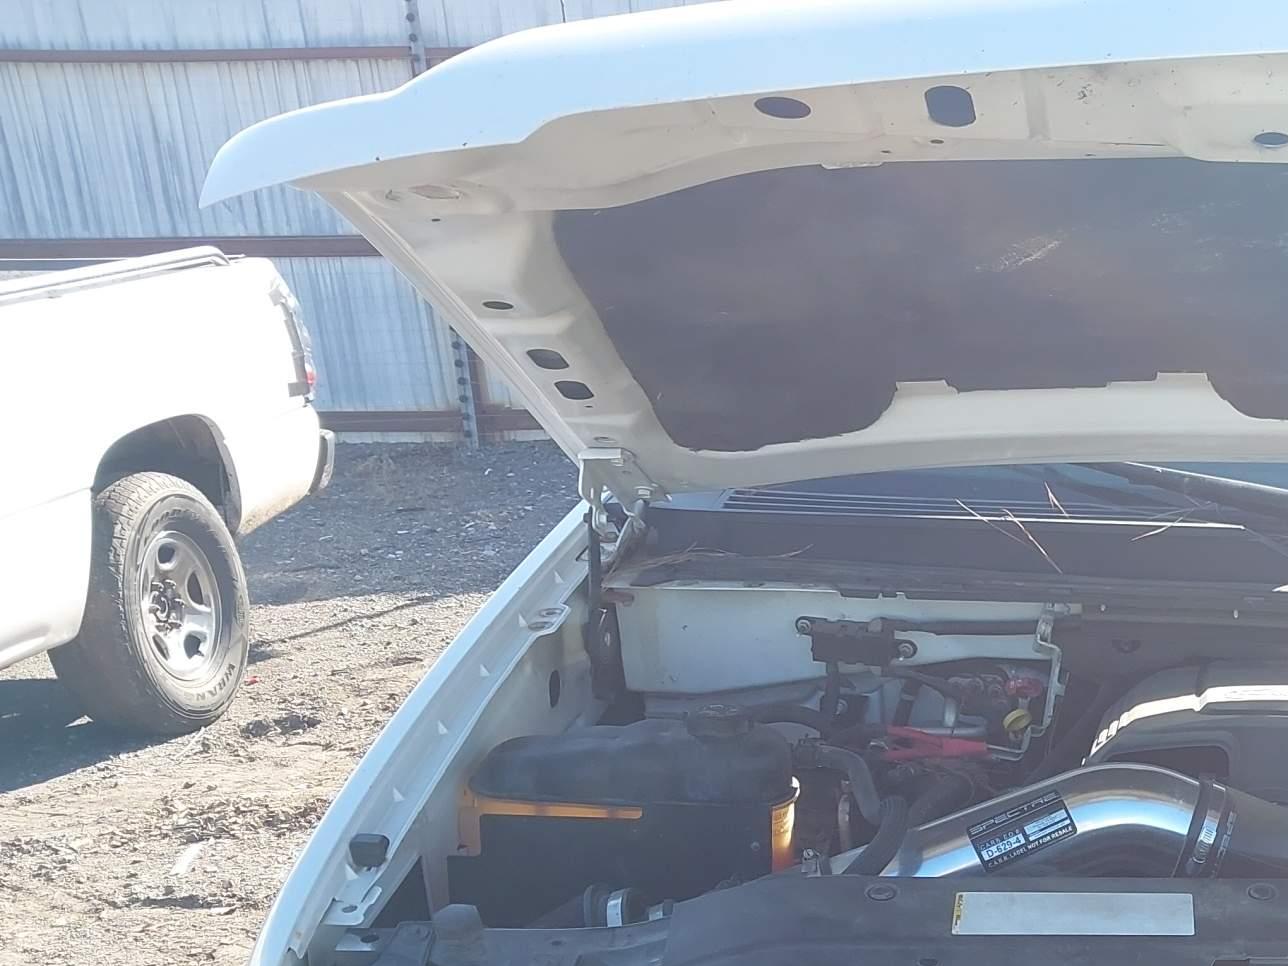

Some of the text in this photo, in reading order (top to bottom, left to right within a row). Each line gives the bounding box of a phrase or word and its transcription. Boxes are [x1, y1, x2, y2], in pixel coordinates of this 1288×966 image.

[969, 792, 1058, 835] SPECTRE
[986, 836, 1022, 858] D-629-4
[1027, 840, 1040, 851] NOT
[1040, 834, 1052, 845] FOR
[1051, 825, 1073, 841] RESALE
